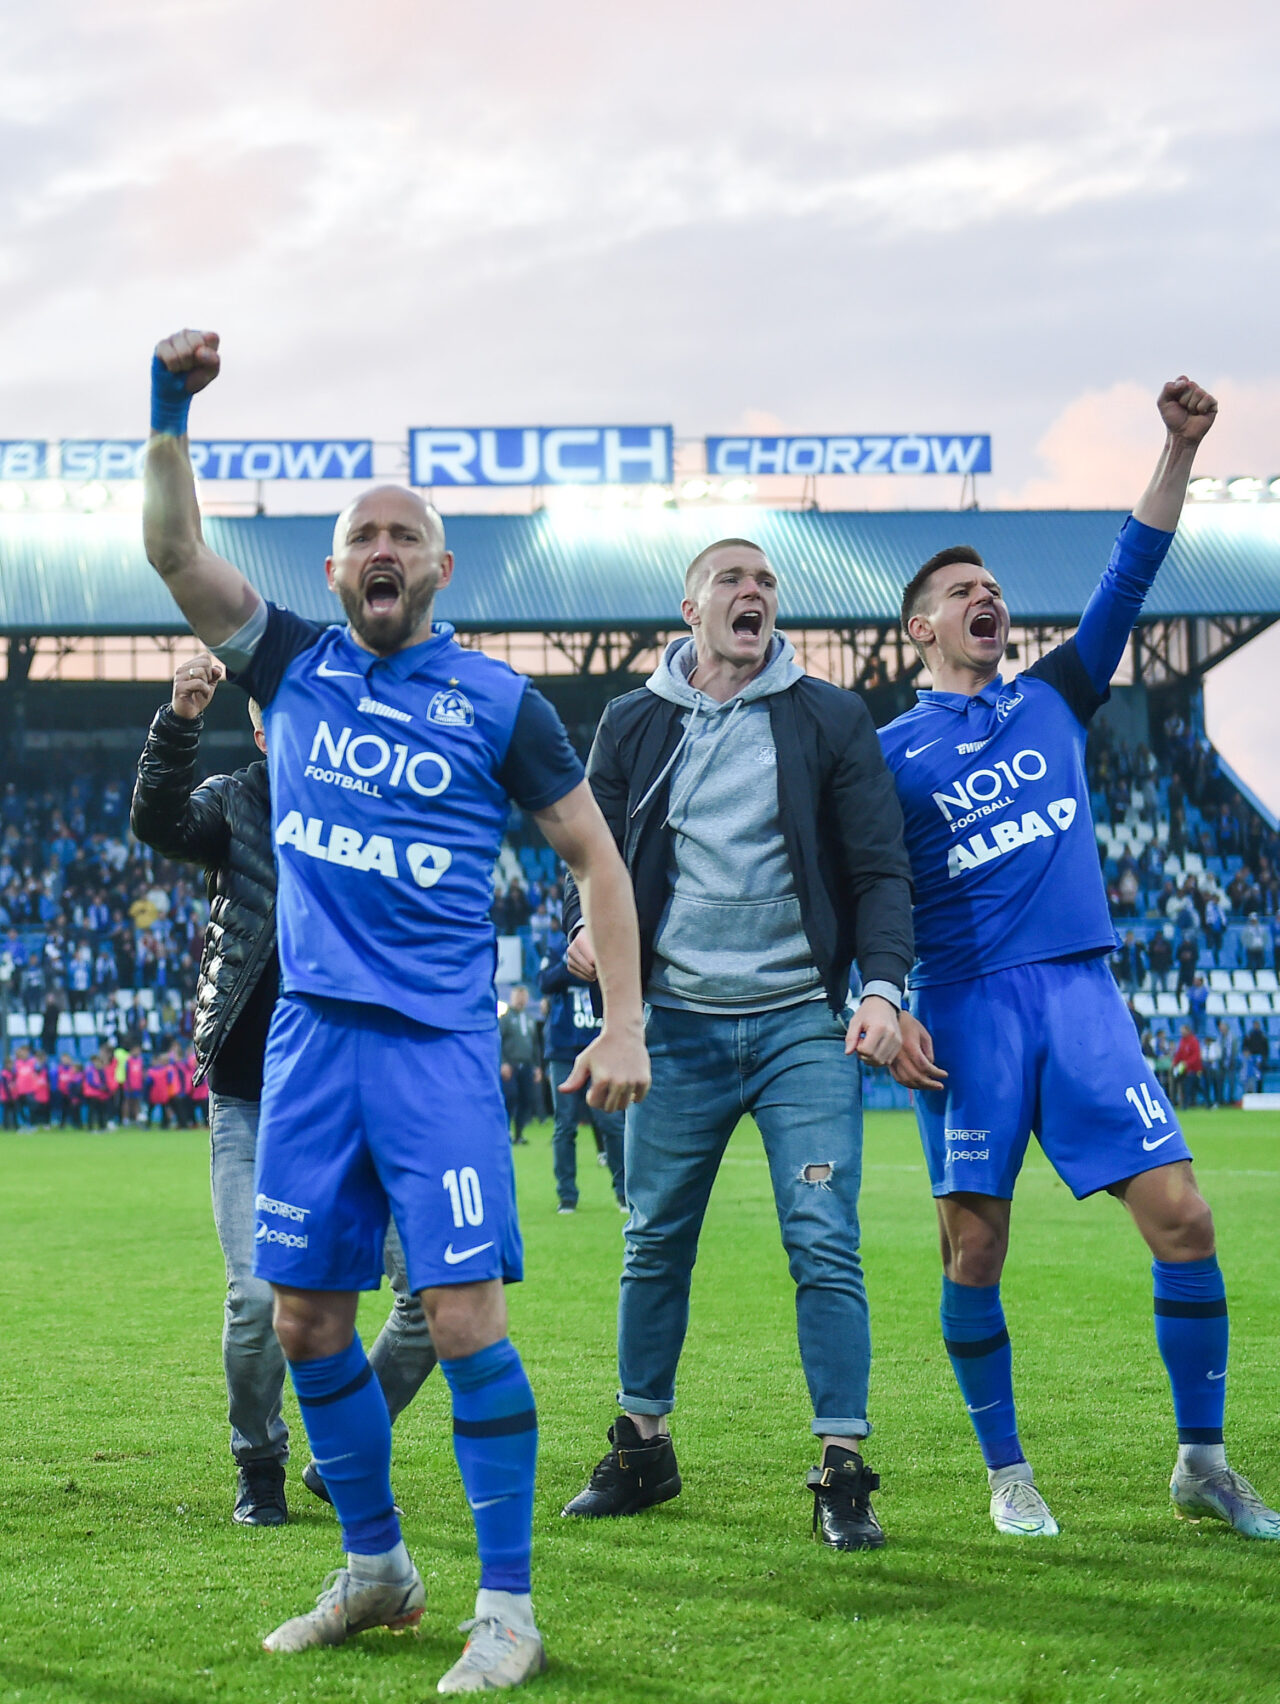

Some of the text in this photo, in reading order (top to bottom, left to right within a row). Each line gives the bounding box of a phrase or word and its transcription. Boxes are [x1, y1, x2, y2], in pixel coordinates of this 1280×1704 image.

[63, 443, 370, 480] SPRTOWY
[414, 428, 668, 485] RUCH
[715, 433, 983, 474] CHORZÓW
[304, 765, 382, 798] FOOTBALL
[309, 720, 452, 797] NO10
[932, 749, 1047, 821] NO10
[949, 796, 1015, 833] FOOTBALL
[275, 810, 399, 878] ALBA
[947, 811, 1055, 879] ALBA
[1125, 1082, 1168, 1129] 14
[952, 1148, 989, 1162] pepsi
[442, 1166, 484, 1228] 10
[267, 1230, 308, 1248] pepsi
